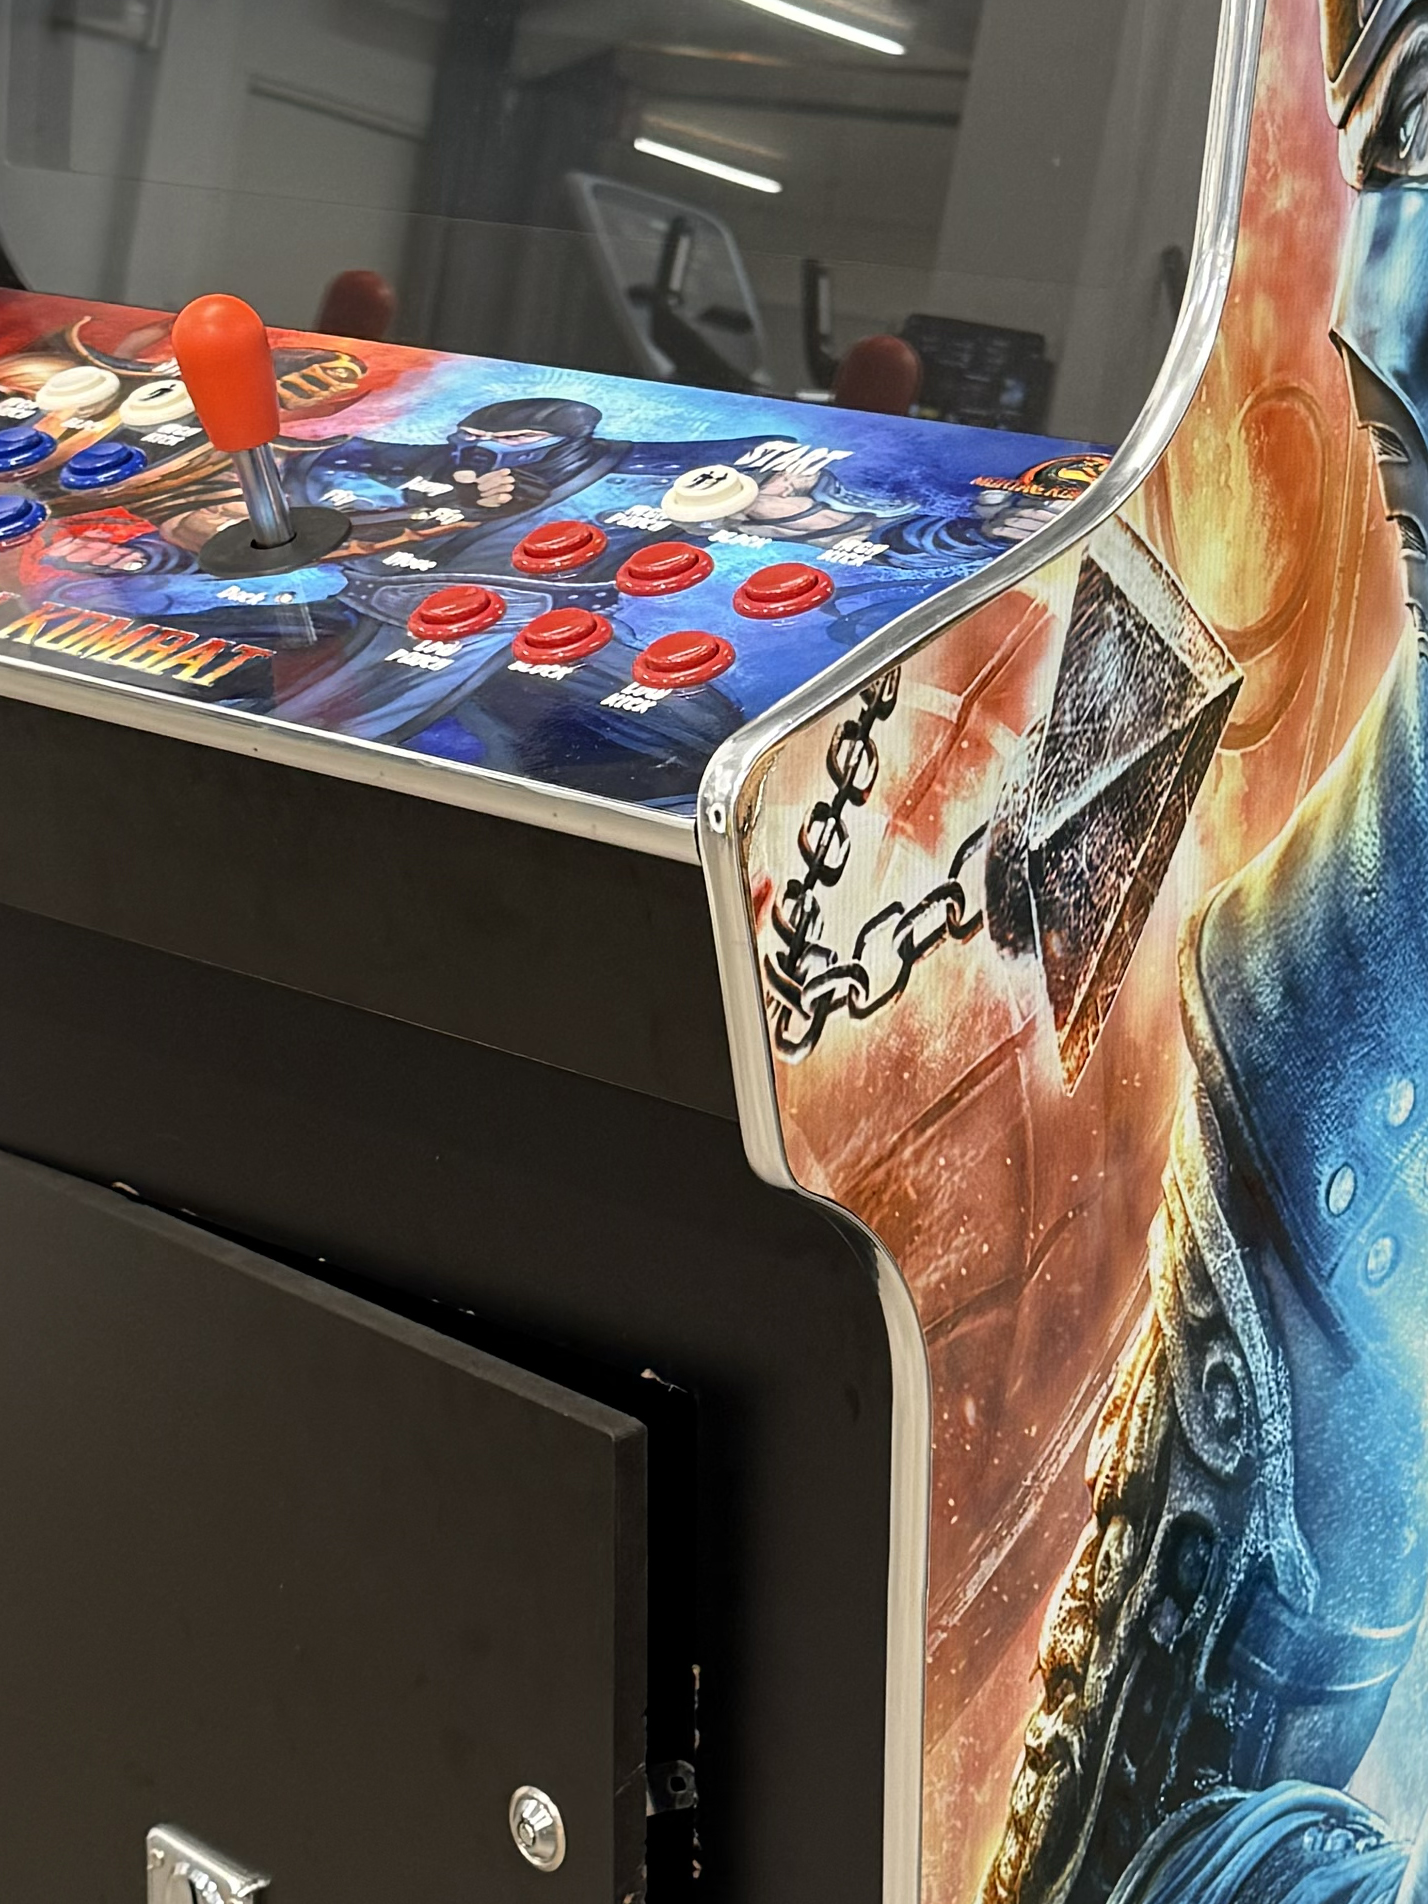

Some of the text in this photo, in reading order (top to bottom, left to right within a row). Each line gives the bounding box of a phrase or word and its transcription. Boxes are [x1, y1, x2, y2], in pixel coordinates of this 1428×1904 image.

[734, 440, 856, 476] START
[708, 529, 774, 550] BLOCK
[816, 549, 874, 568] KICK
[508, 661, 577, 681] BLOCK
[600, 692, 659, 714] KICK
